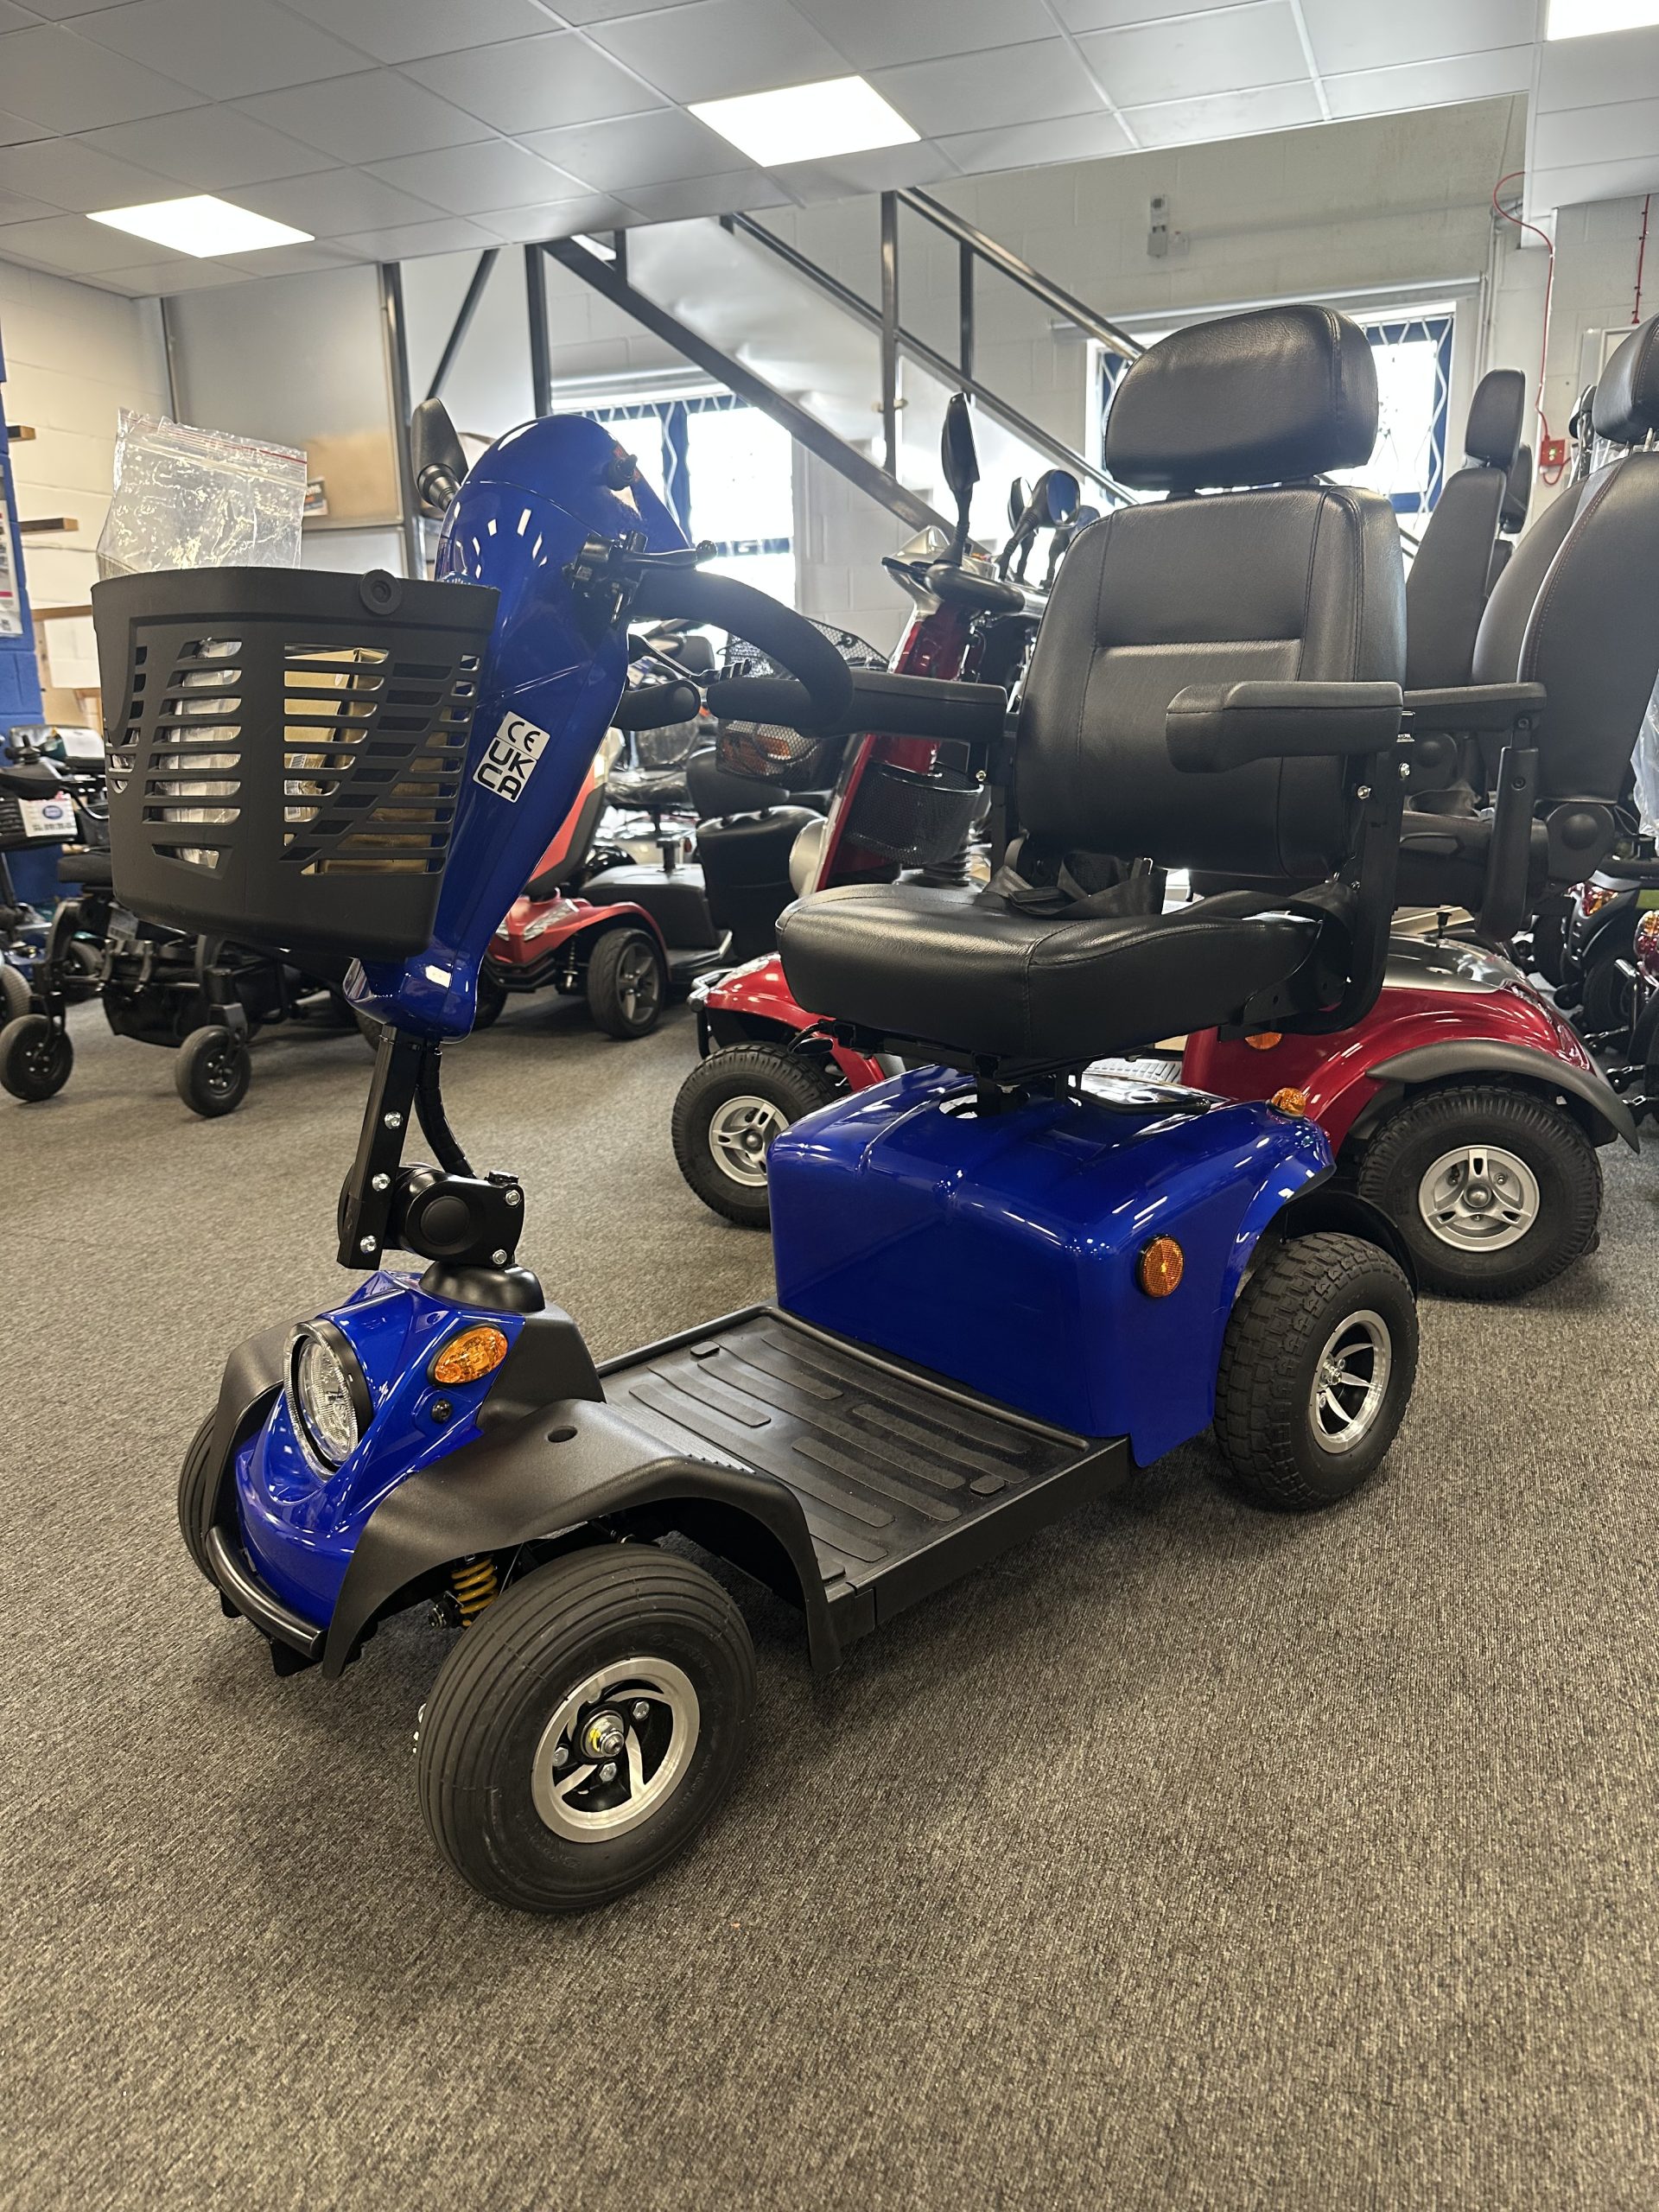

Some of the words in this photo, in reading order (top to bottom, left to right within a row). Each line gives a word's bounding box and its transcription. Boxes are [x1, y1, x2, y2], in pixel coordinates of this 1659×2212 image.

[507, 721, 541, 753] CE
[488, 739, 535, 780] UK
[477, 762, 522, 801] CA
